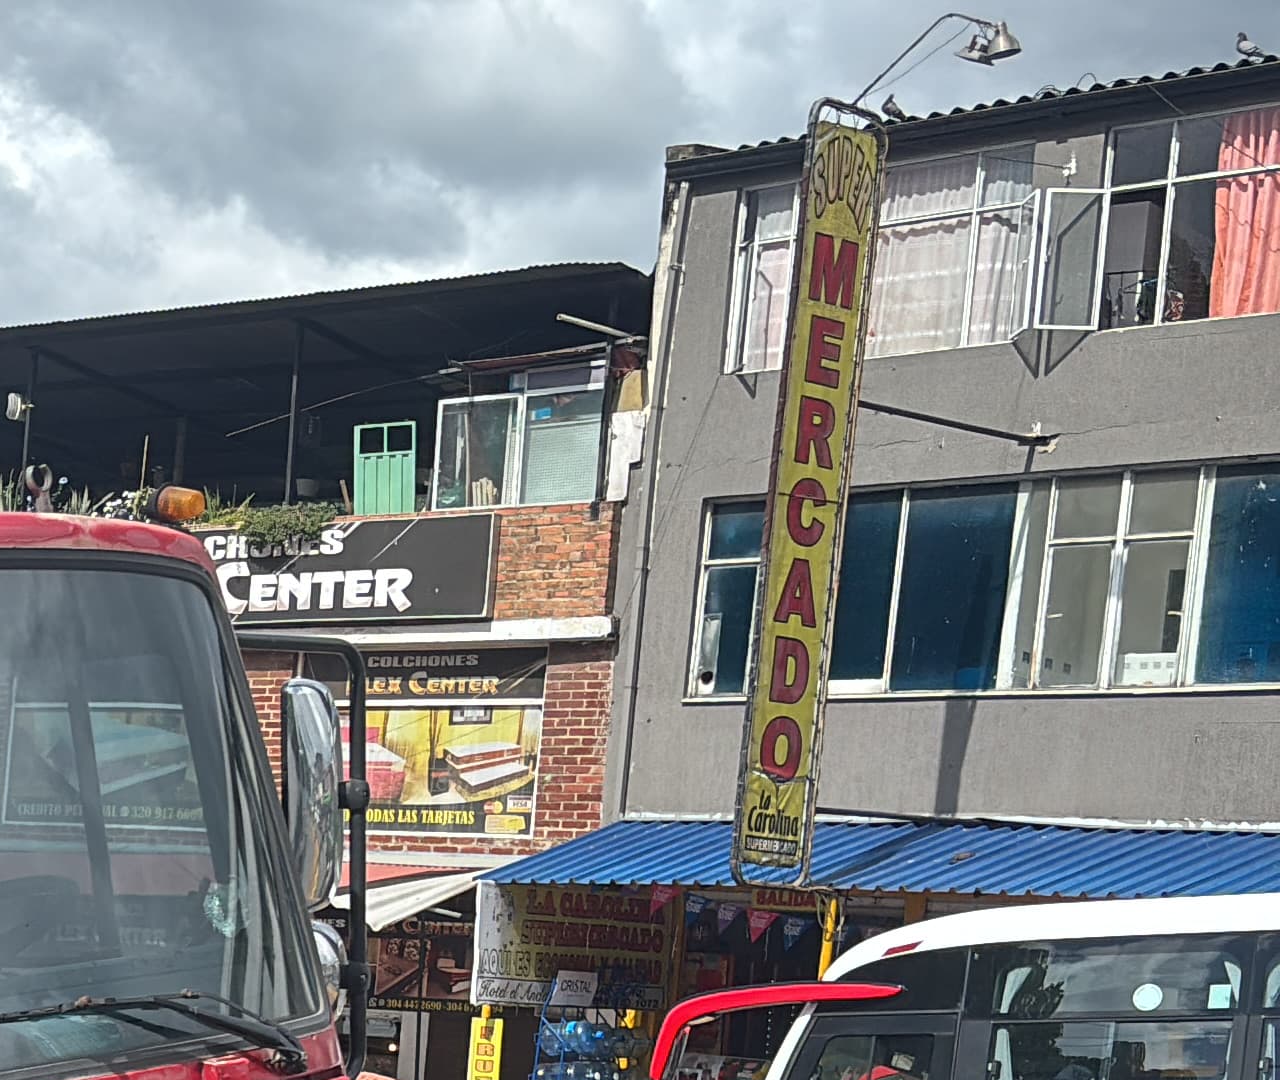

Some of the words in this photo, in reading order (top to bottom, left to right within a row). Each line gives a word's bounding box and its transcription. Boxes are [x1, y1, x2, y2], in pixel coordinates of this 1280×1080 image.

[811, 135, 873, 234] SUPER
[759, 231, 860, 782] MERCADO
[214, 561, 414, 615] CENTER
[368, 654, 479, 668] COLCHONES
[408, 671, 500, 695] CENTER
[365, 808, 395, 823] ODAS
[397, 809, 418, 824] LAS
[421, 810, 475, 826] TARJETAS
[747, 805, 799, 837] Carolina
[560, 978, 592, 994] CRISTAL
